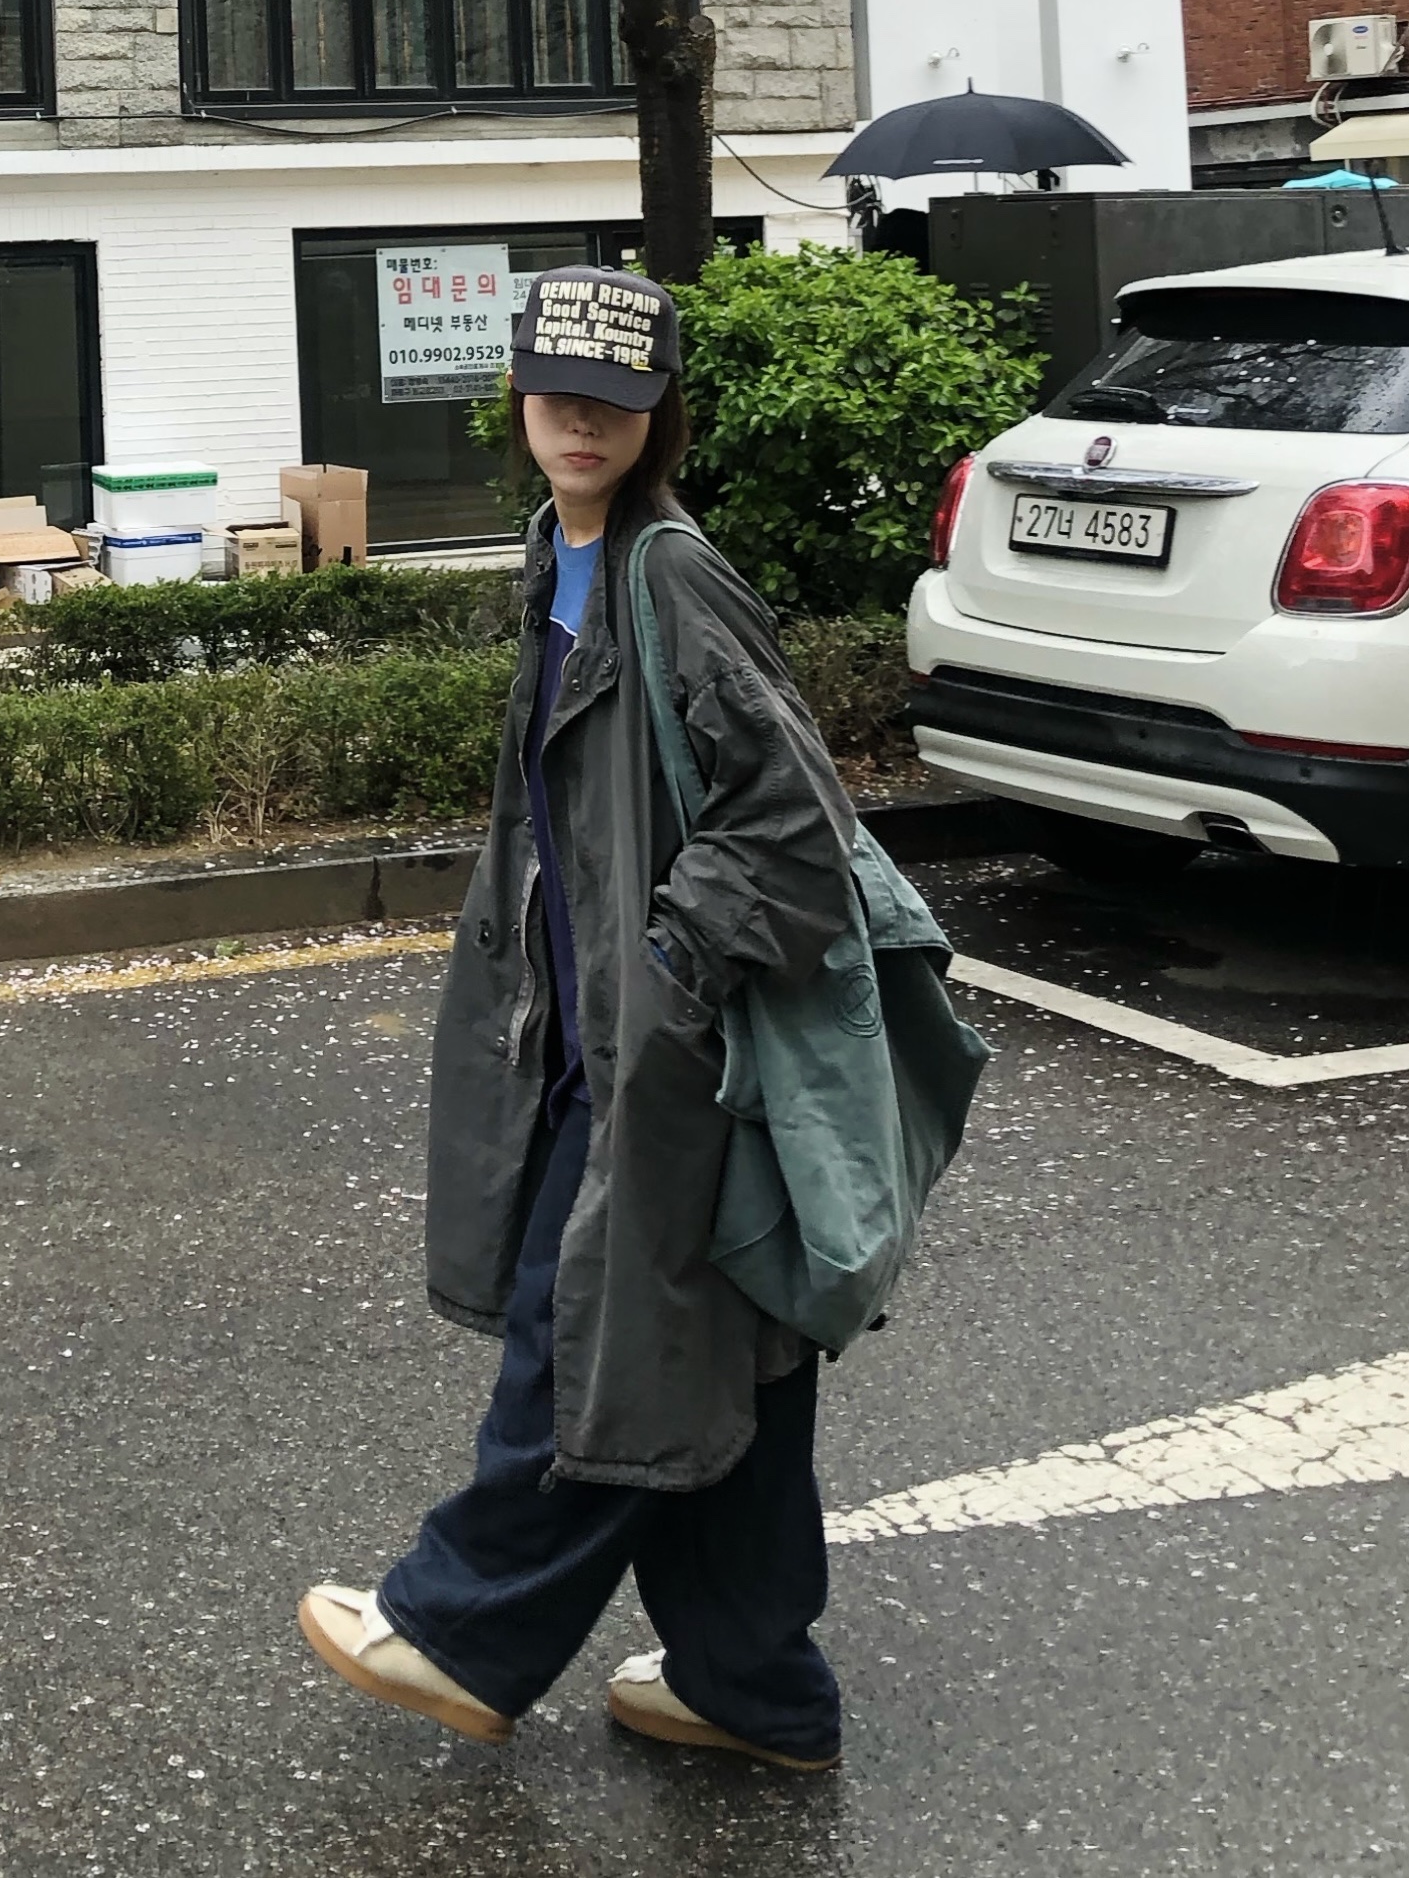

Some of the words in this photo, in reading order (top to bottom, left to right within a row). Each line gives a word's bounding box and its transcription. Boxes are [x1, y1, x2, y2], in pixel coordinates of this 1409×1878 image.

[393, 274, 496, 305] 임대문의
[539, 281, 593, 301] DENIM
[598, 283, 660, 316] REPAIR
[450, 313, 488, 333] 부동산
[542, 299, 581, 319] Good
[587, 301, 652, 332] Service
[593, 322, 654, 352] Kountry
[389, 344, 505, 365] 010.9902.9529
[1026, 504, 1074, 540] 27너
[1084, 509, 1152, 549] 4583
